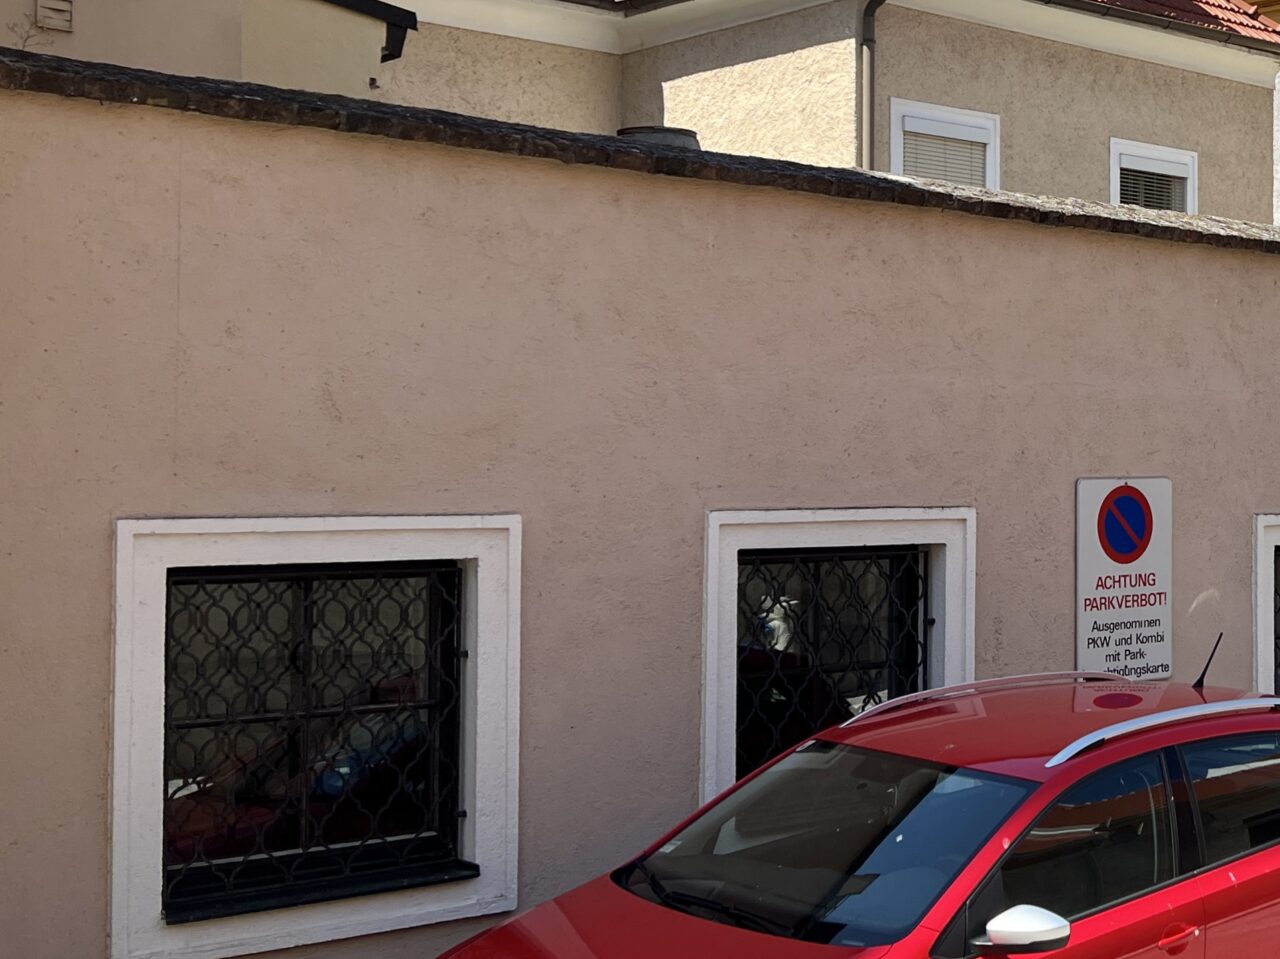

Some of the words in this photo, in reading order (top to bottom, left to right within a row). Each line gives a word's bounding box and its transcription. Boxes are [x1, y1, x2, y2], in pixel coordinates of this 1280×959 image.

[1095, 572, 1156, 590] ACHTUNG
[1084, 592, 1167, 612] PARKVERBOT!
[1087, 635, 1111, 649] PKW
[1114, 634, 1133, 647] und
[1135, 631, 1165, 645] Kombi
[1105, 650, 1121, 663] mit
[1124, 648, 1147, 661] Park-
